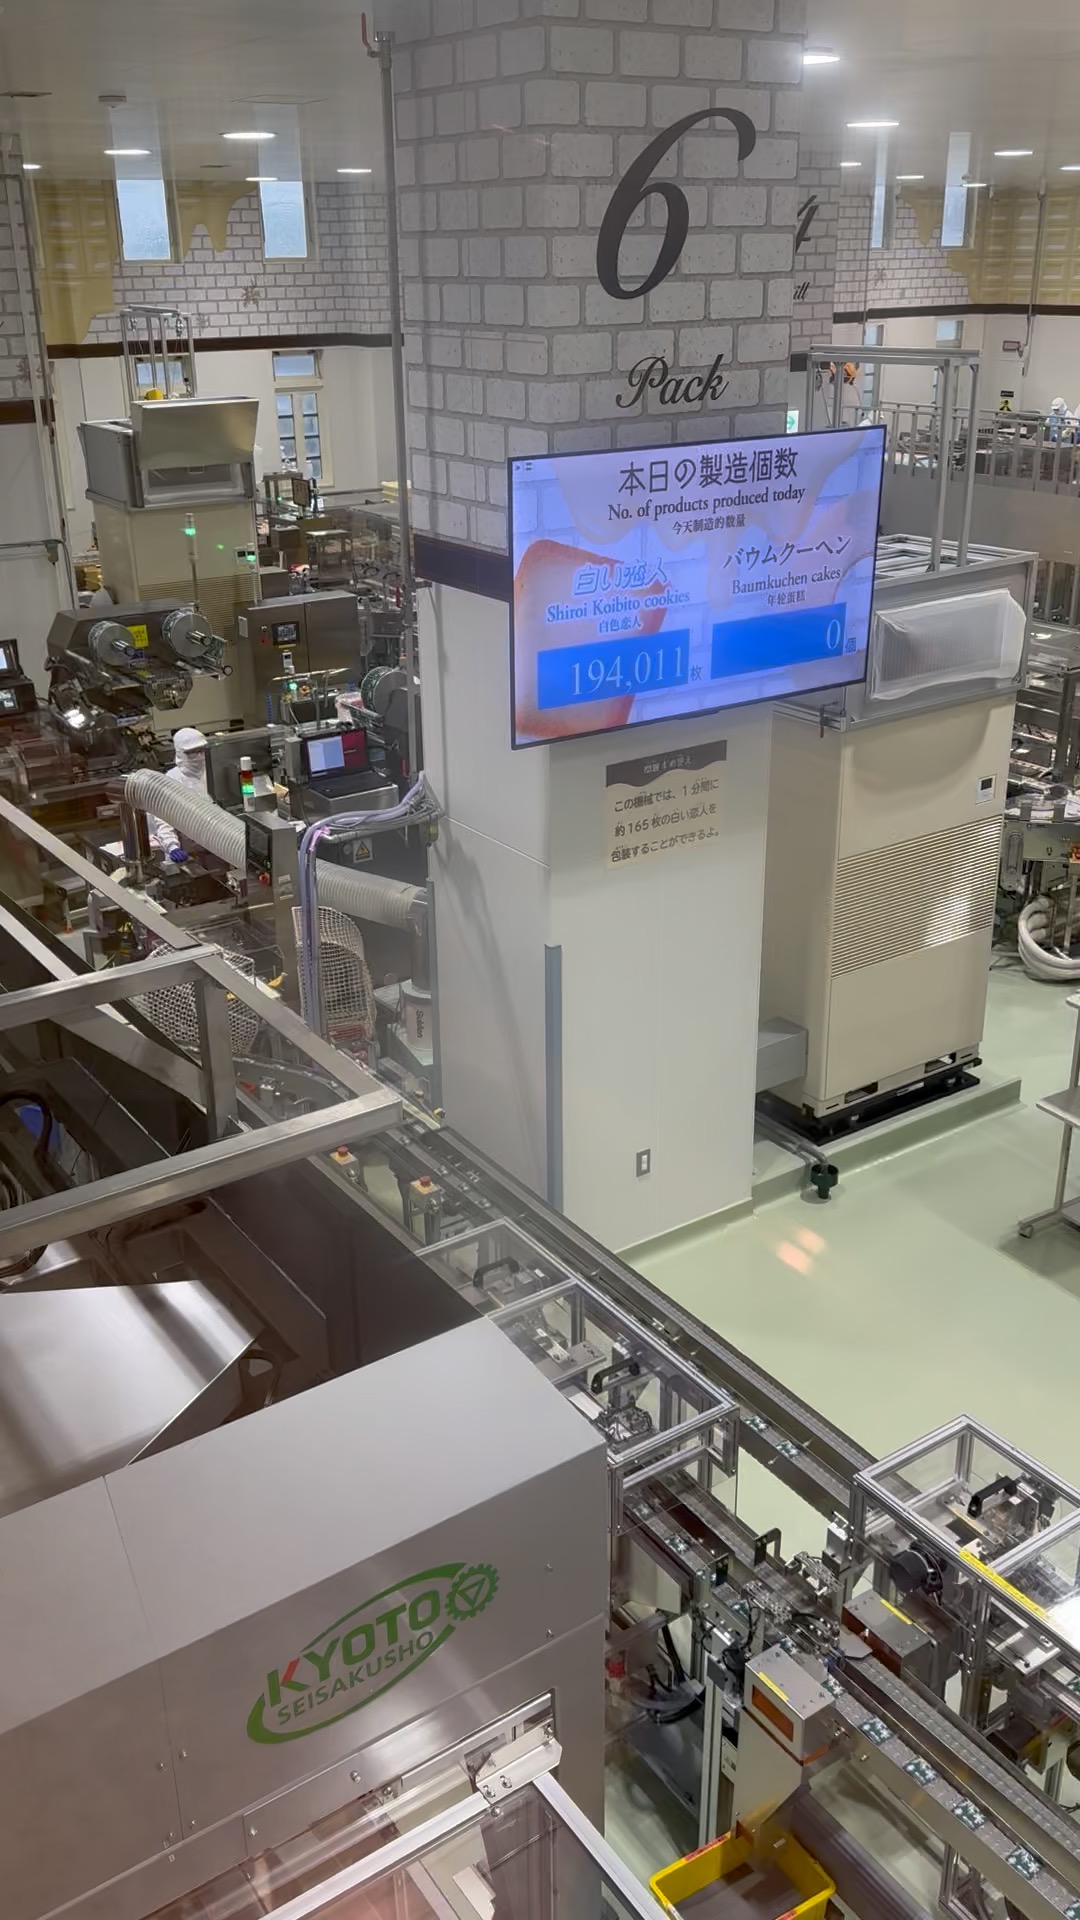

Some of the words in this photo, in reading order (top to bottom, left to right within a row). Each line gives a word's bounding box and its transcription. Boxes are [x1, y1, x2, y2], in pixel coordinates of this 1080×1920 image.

[596, 107, 756, 300] 6
[615, 354, 729, 408] Pack
[618, 447, 799, 497] 本日の製造個数
[608, 503, 632, 521] No.
[637, 499, 653, 518] of
[654, 496, 709, 521] products
[713, 487, 769, 513] produced
[773, 484, 805, 504] today
[672, 514, 746, 536] 今天制造的数量
[722, 536, 851, 571] バウムクーヘン
[573, 557, 668, 595] 白い恋人
[732, 571, 808, 595] Baumkuchen
[811, 566, 841, 583] cakes
[547, 603, 588, 622] Shiroi
[593, 596, 641, 616] Koibito
[644, 589, 690, 609] cookies
[599, 616, 642, 633] 白色恋人
[826, 619, 841, 649] 0
[572, 646, 682, 696] 194,011
[691, 665, 703, 681] 枚
[267, 1589, 441, 1707] KYOTO
[277, 1631, 434, 1726] SEISAKUSHO
